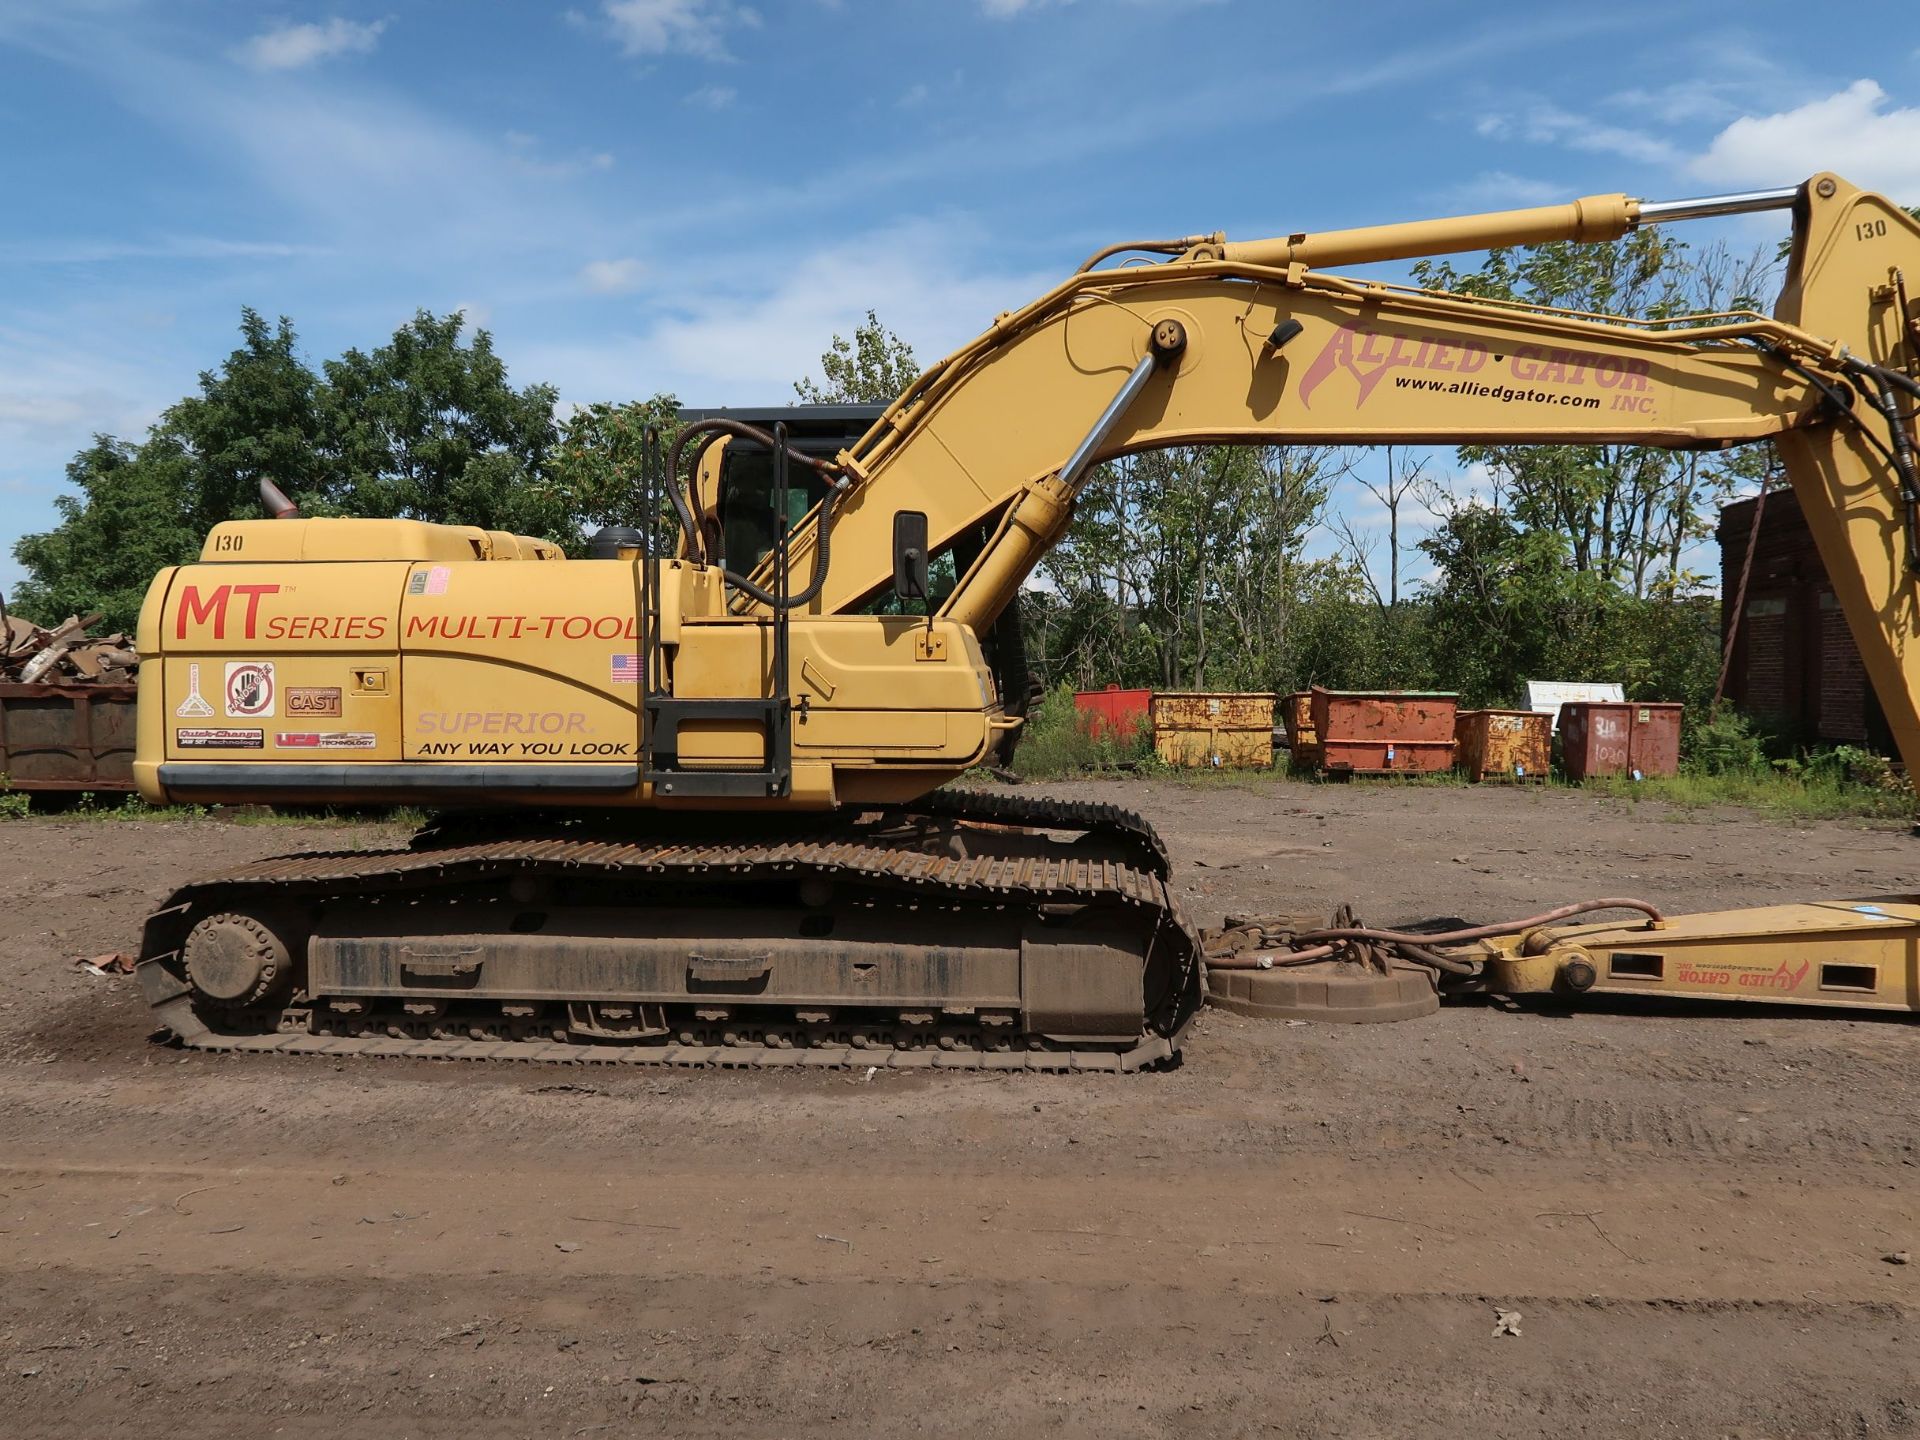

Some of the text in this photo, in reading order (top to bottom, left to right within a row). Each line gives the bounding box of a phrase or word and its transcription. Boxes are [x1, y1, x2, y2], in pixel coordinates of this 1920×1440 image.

[1856, 219, 1887, 242] 130
[1299, 320, 1488, 411] ALLIED
[1395, 375, 1601, 410] www.alliedgator.com
[1609, 393, 1658, 415] INC.
[215, 535, 244, 552] 130
[176, 584, 281, 640] MT
[265, 616, 388, 640] SERIES
[406, 615, 644, 640] MULTI-TOOL
[228, 683, 254, 713] HANDS
[289, 694, 338, 710] CAST
[417, 743, 462, 754] ANY
[468, 743, 514, 754] WAY
[520, 743, 563, 754] YOU
[569, 743, 630, 754] LOOK
